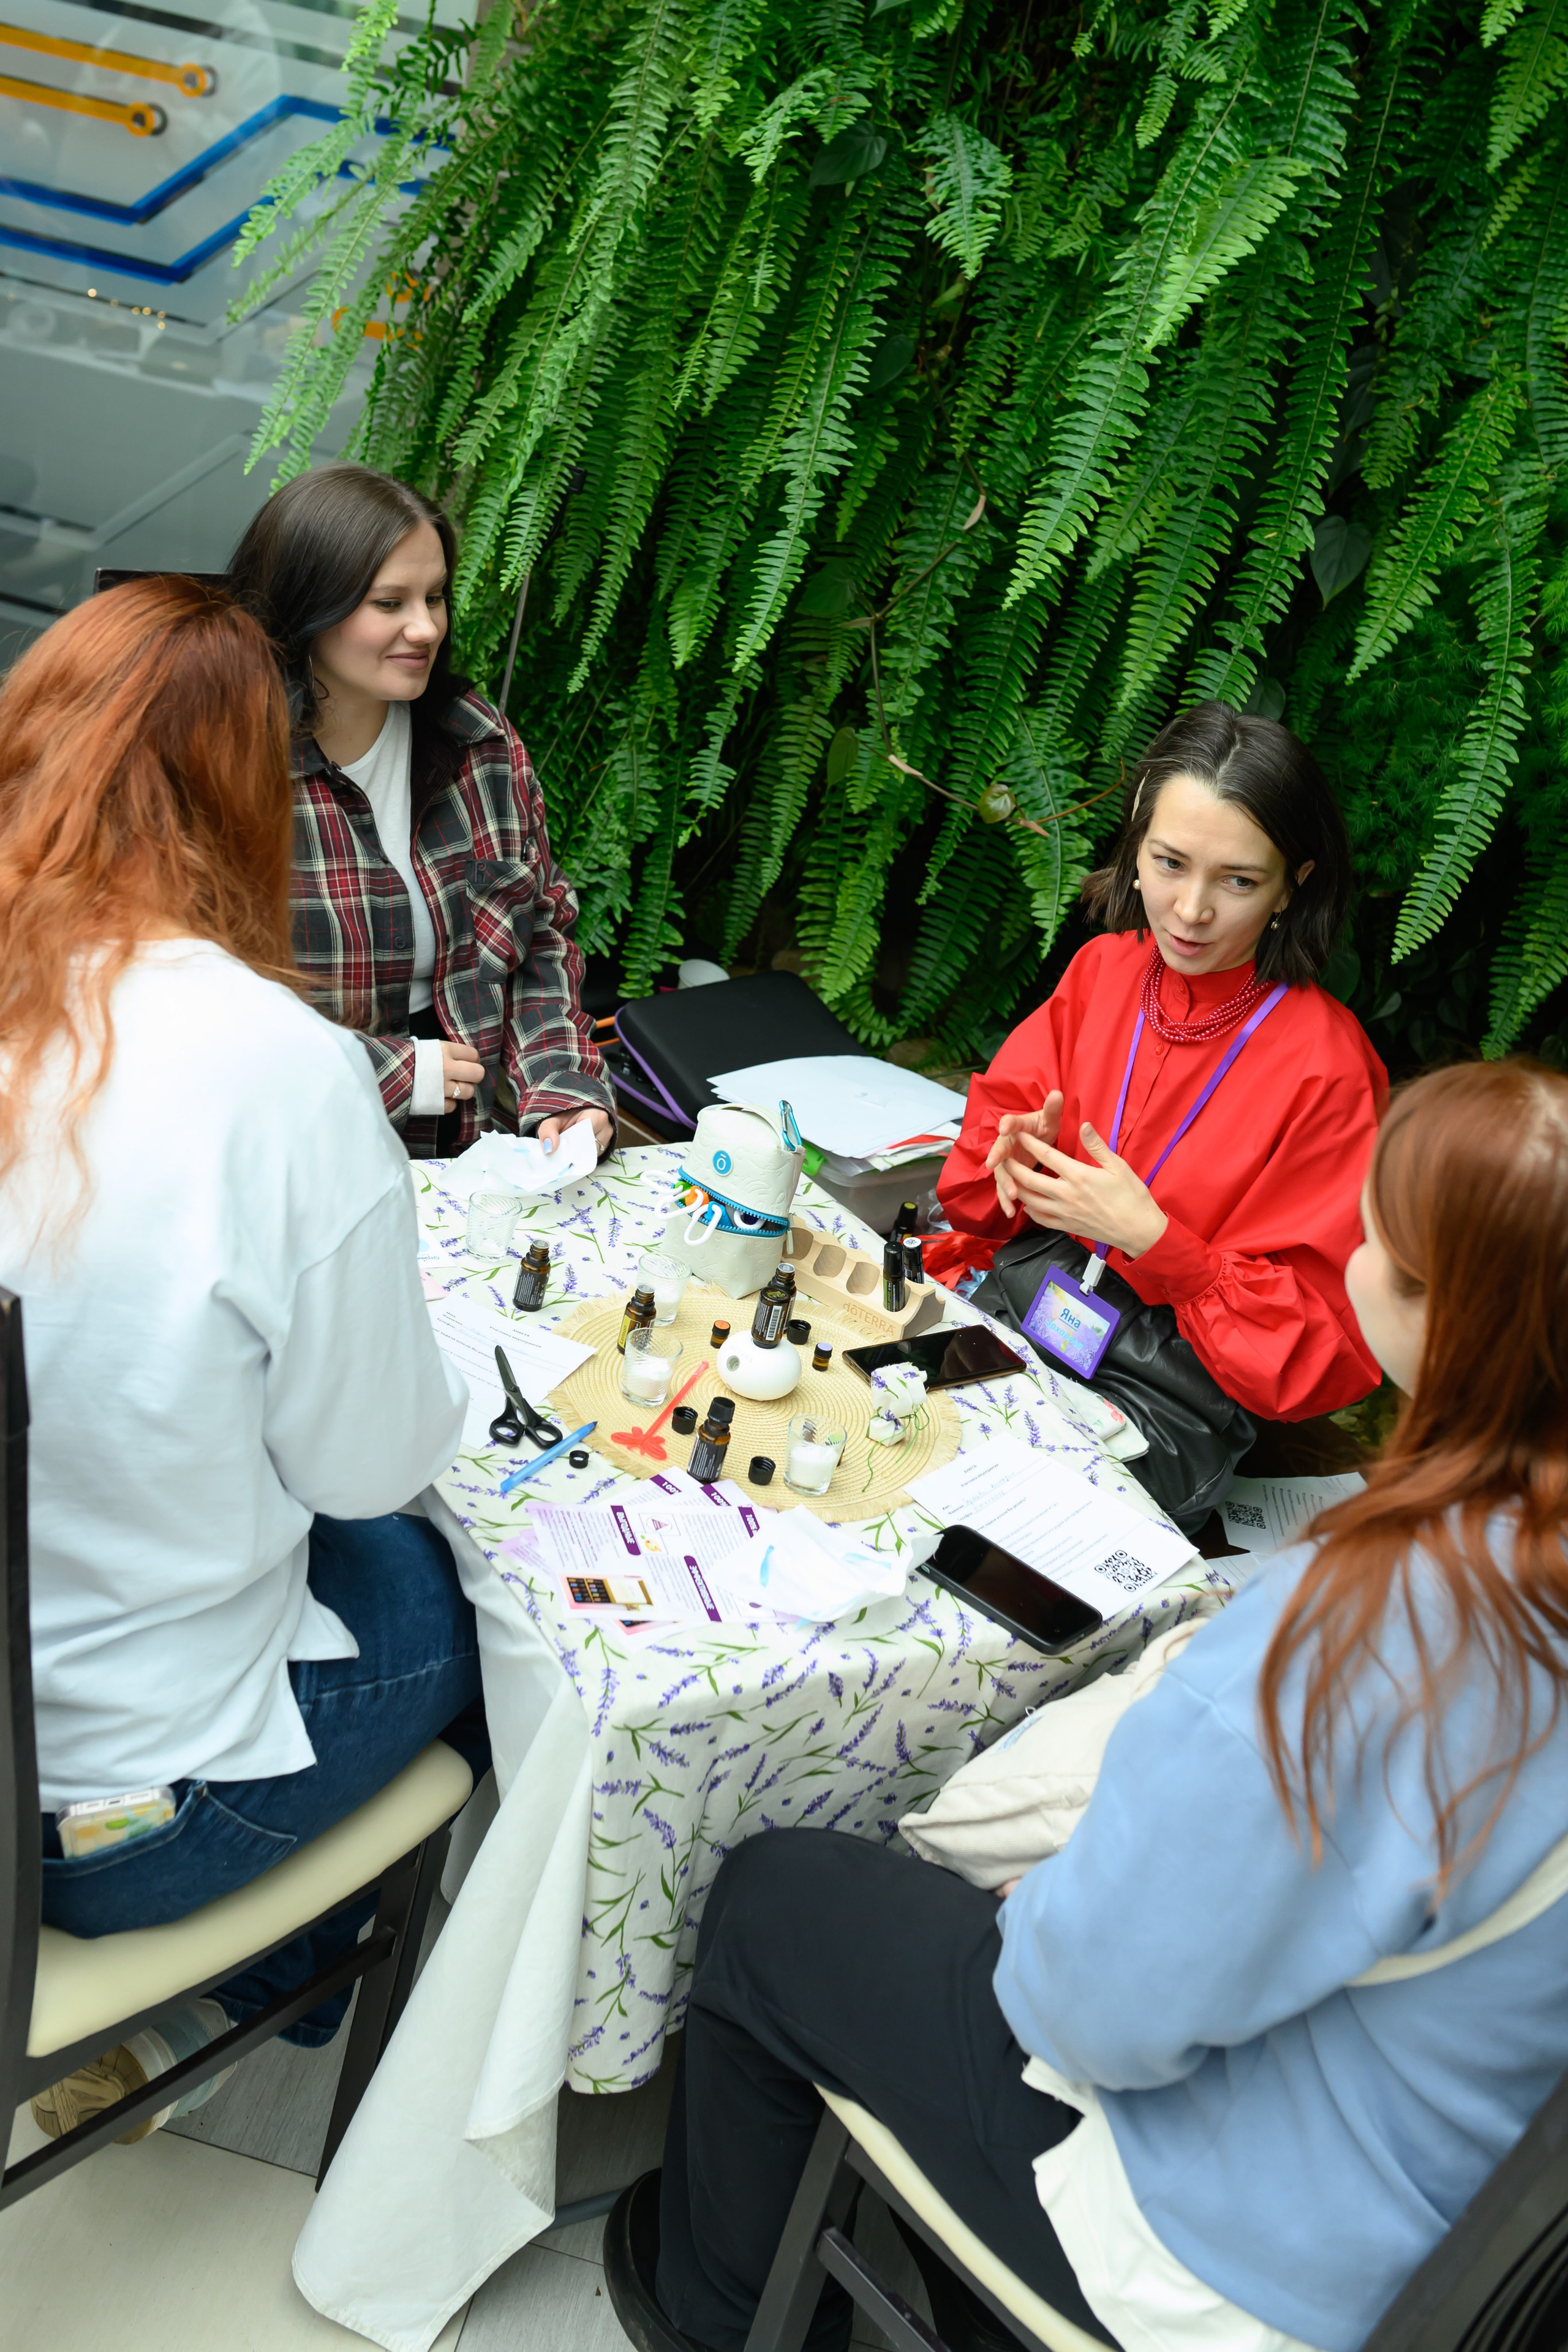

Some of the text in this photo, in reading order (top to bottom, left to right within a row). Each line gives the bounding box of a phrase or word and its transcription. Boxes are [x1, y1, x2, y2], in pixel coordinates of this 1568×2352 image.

[843, 1302, 894, 1336] dōTERRA
[1060, 1308, 1081, 1329] Яна
[1046, 1319, 1084, 1351] Захарова
